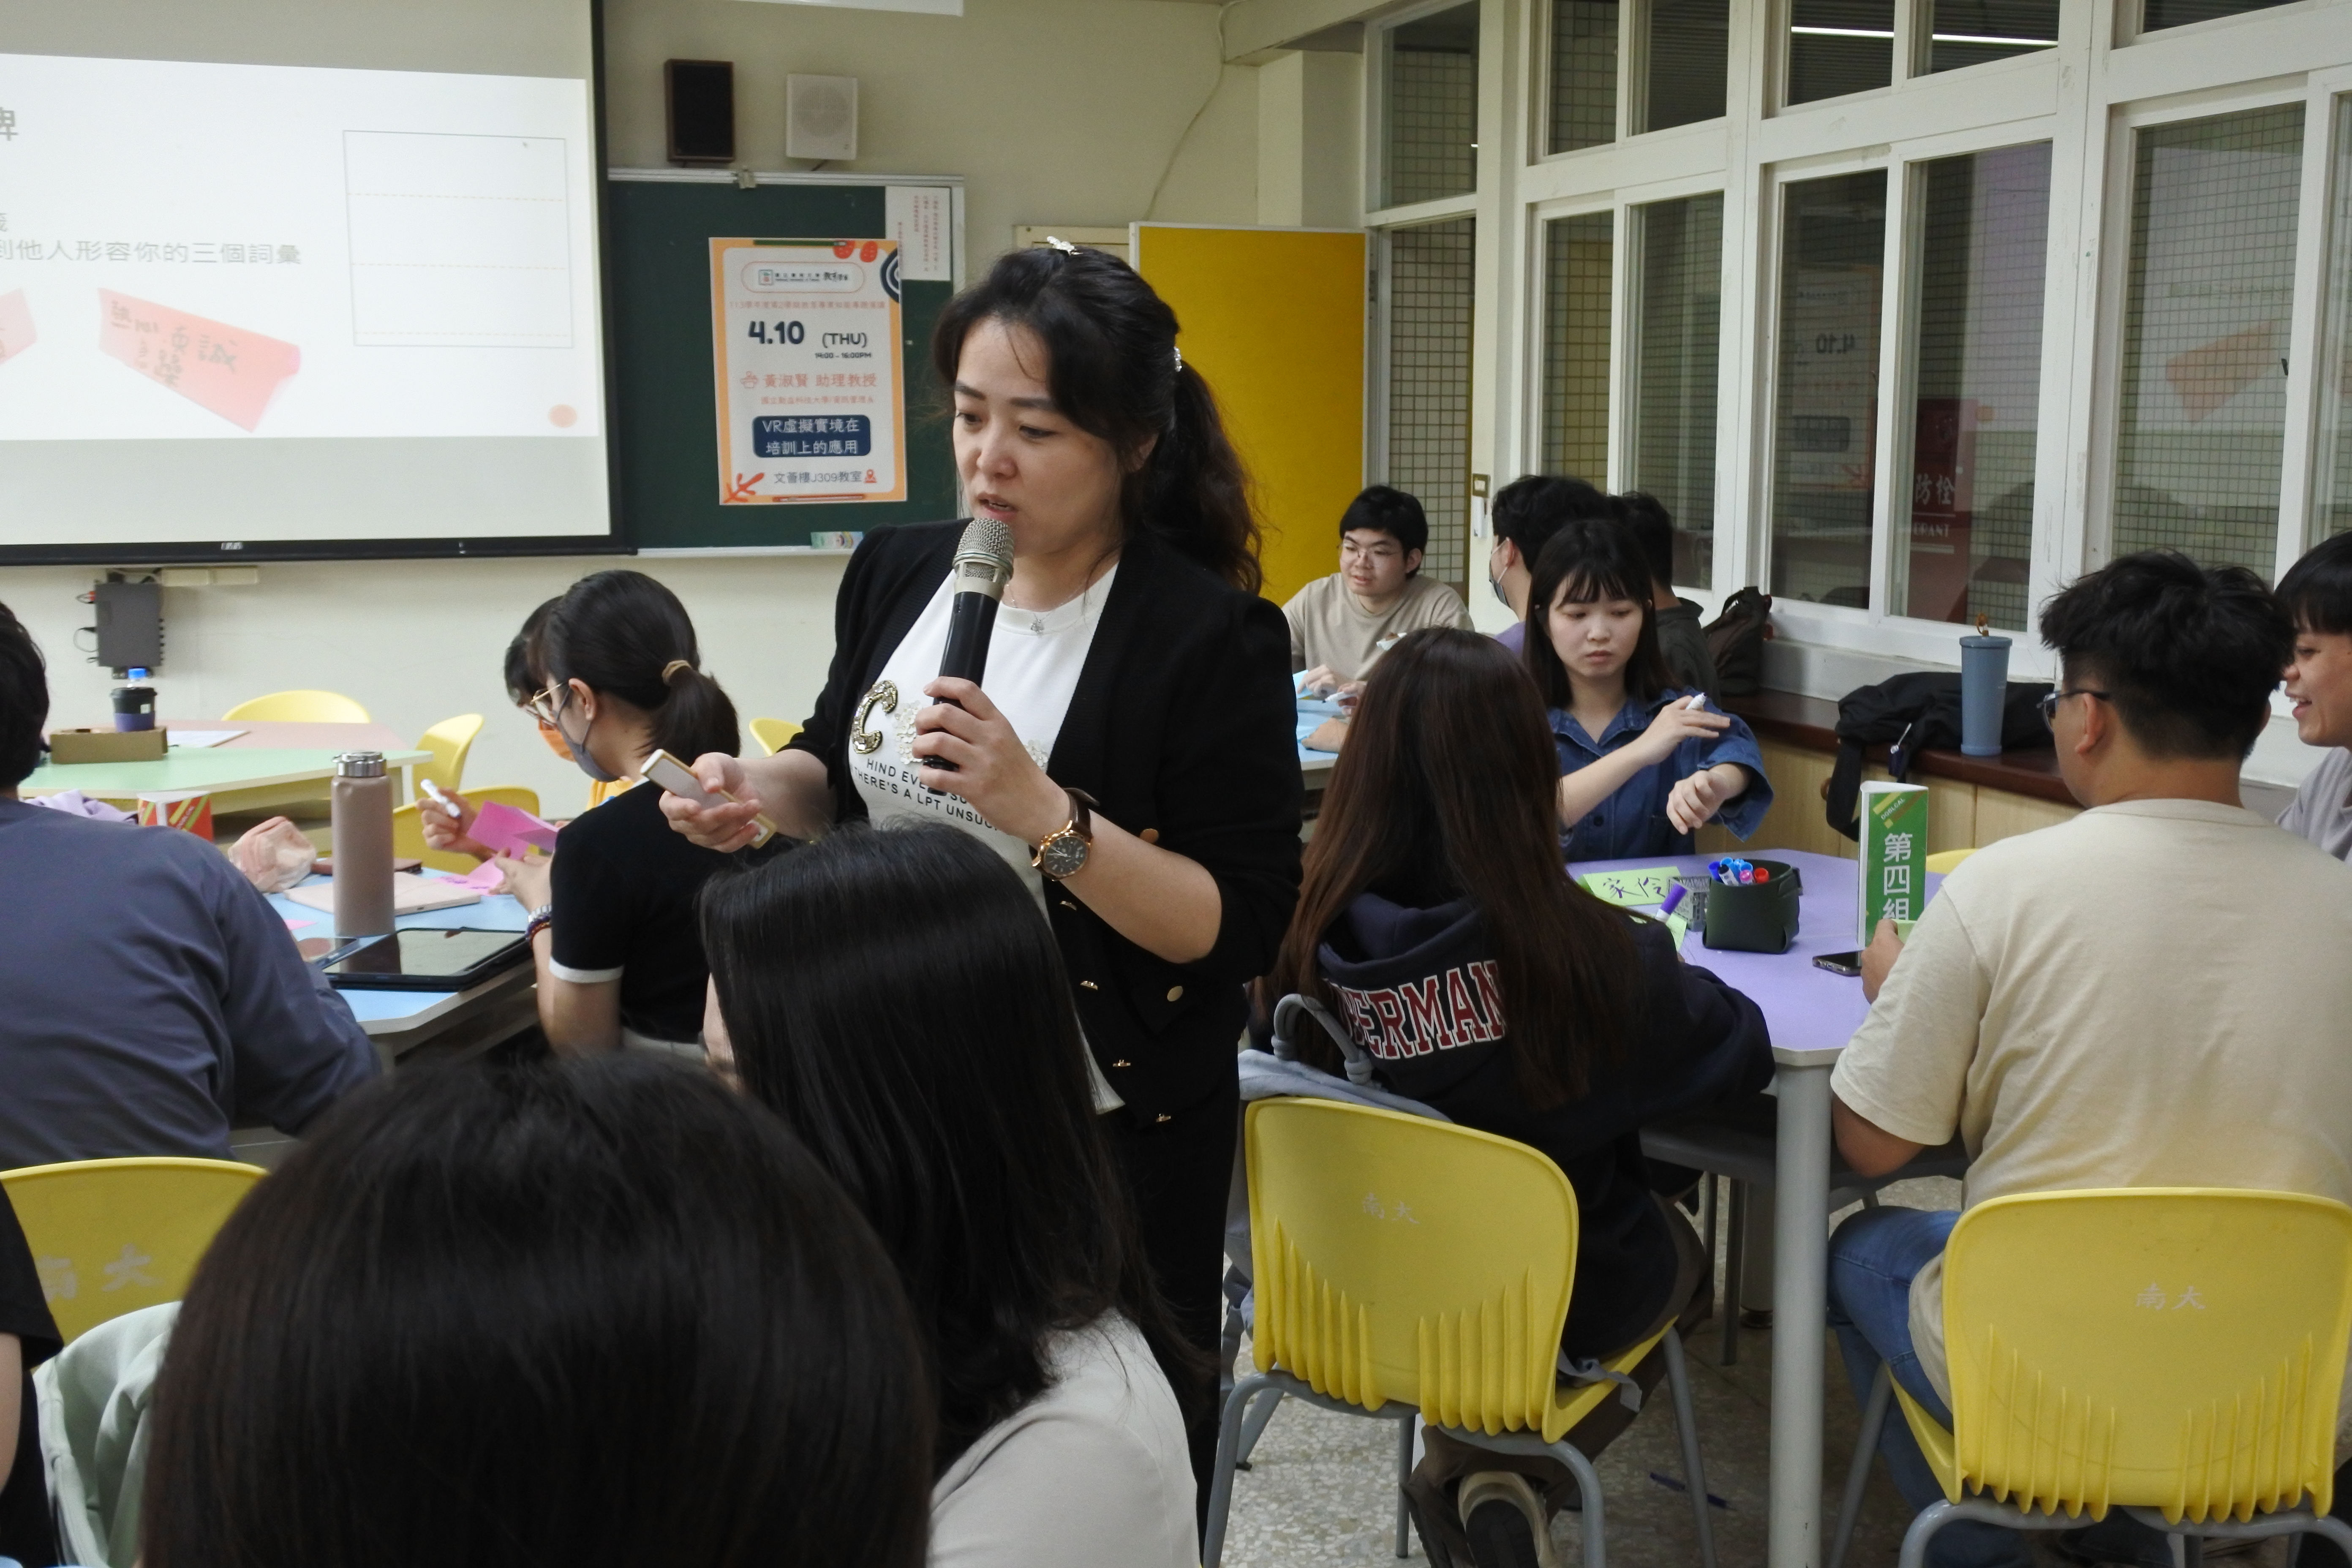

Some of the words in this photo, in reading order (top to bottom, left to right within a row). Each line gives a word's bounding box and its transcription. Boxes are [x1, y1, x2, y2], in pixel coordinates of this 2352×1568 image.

[748, 321, 804, 344] 4.10
[822, 332, 867, 348] (THU)
[816, 373, 877, 387] 助理教授
[766, 440, 858, 455] 培訓上的應用
[866, 758, 896, 777] HIND
[854, 767, 898, 794] THERE'S
[904, 788, 912, 800] A
[917, 793, 941, 810] LPT
[947, 804, 997, 831] UNSU
[1883, 832, 1913, 920] 第四組
[1322, 959, 1507, 1060] ERMAN
[2136, 1282, 2206, 1310] 南大
